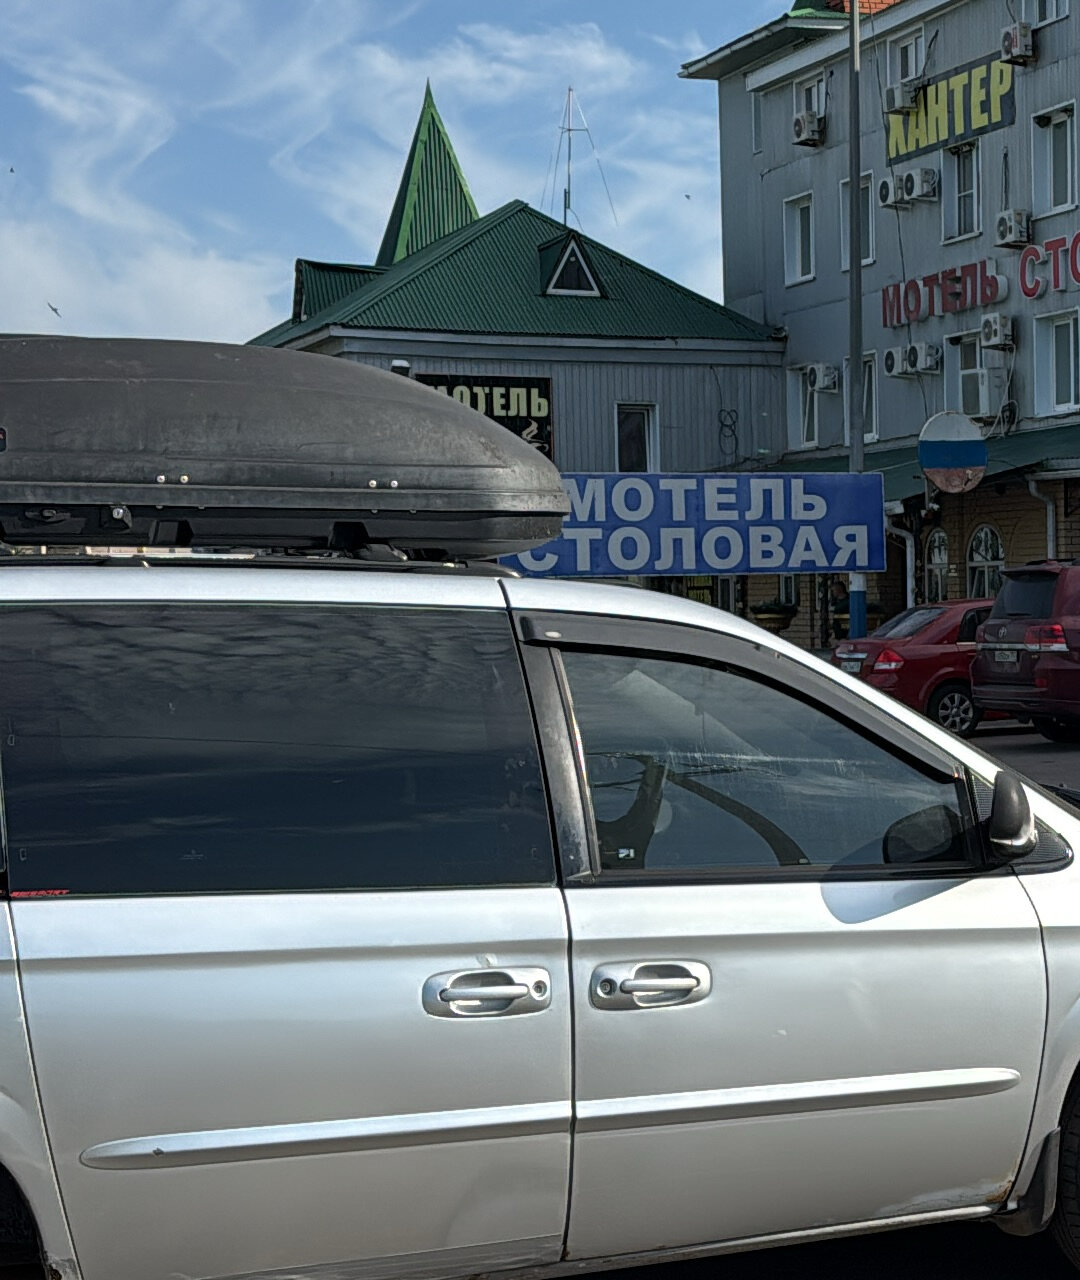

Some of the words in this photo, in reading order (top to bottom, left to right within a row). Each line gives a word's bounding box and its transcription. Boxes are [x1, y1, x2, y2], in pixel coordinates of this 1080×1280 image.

[888, 59, 1012, 159] ХАНТЕР
[882, 259, 1000, 328] МОТЕЛЬ
[429, 385, 549, 417] ОТЕЛЬ
[562, 477, 828, 522] МОТЕЛЬ
